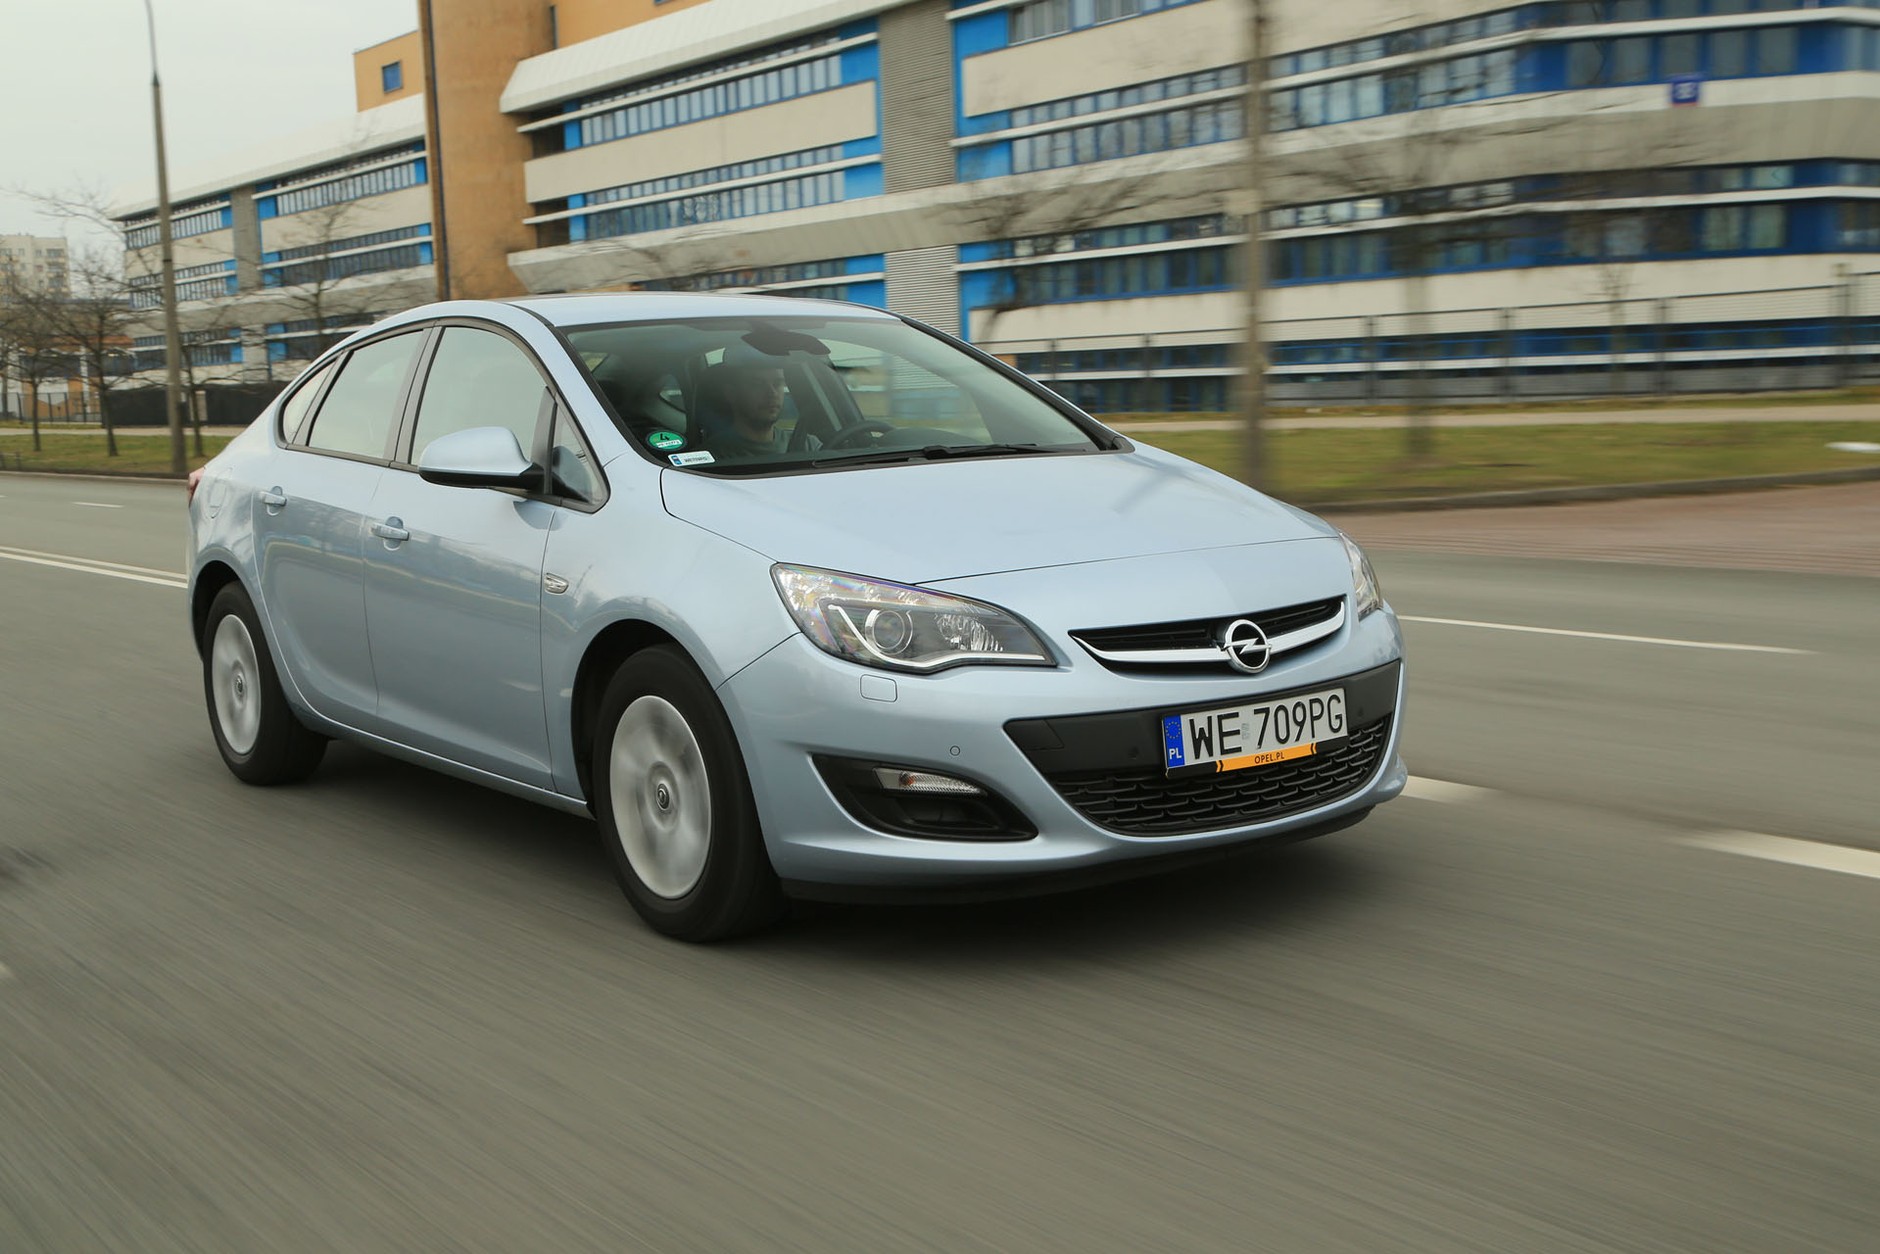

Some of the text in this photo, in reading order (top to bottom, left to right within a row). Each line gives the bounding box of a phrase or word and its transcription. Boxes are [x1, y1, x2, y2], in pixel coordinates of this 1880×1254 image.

[1188, 694, 1343, 760] WE 709PG
[1168, 748, 1182, 760] PL
[1254, 752, 1285, 764] OPEL.PL
